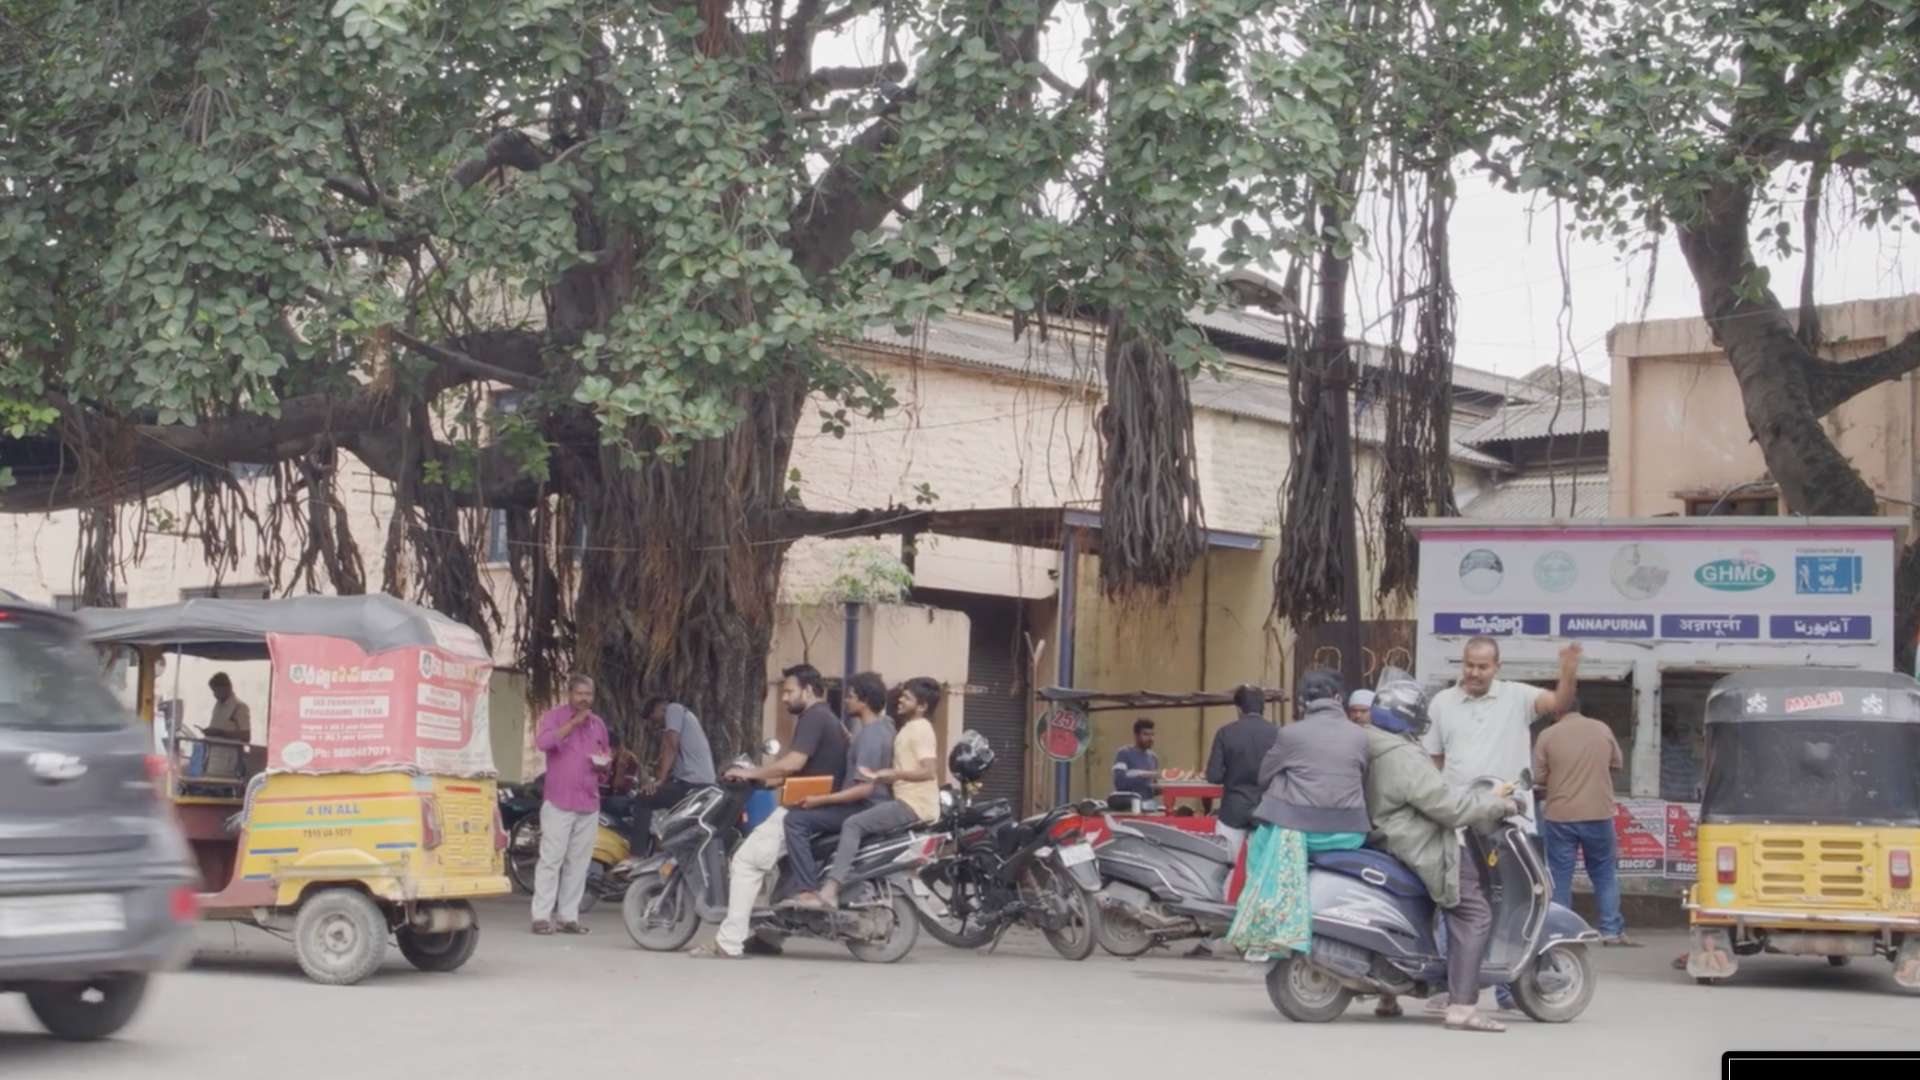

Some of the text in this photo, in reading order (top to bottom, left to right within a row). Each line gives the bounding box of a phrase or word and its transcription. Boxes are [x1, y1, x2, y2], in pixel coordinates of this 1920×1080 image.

[1702, 566, 1768, 582] GHMC
[1567, 618, 1648, 631] ANNAPURNA
[1786, 690, 1844, 713] MAAJI
[1052, 708, 1086, 731] 25/-
[314, 748, 331, 758] Ph:
[306, 802, 361, 816] 4 IN ALL
